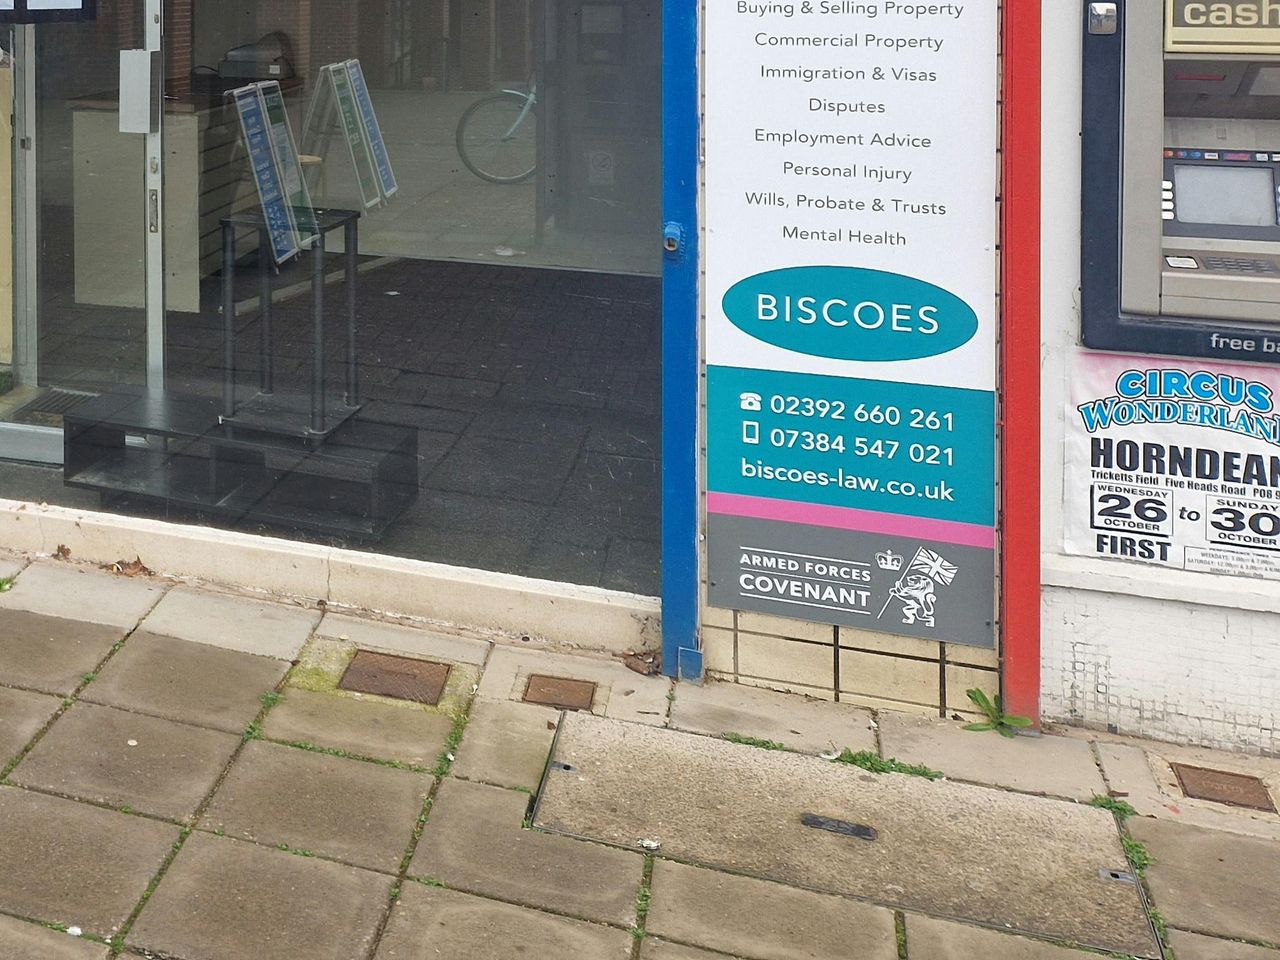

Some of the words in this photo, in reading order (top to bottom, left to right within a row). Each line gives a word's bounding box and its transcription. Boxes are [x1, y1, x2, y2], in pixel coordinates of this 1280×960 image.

[737, 0, 794, 18] Buying
[800, 0, 814, 14] &
[820, 0, 878, 19] Selling
[885, 1, 964, 20] Property
[754, 32, 858, 47] Commercial
[865, 33, 944, 53] Property
[761, 64, 865, 83] Immigration
[871, 66, 885, 81] &
[891, 67, 937, 82] Visas
[809, 97, 886, 116] Disputes
[755, 128, 864, 148] Employment
[870, 132, 932, 148] Advice
[783, 161, 857, 178] Personal
[864, 165, 912, 184] Injury
[745, 191, 789, 209] Wills,
[796, 194, 866, 211] Probate
[871, 198, 885, 212] &
[890, 198, 947, 216] Trusts
[783, 225, 842, 242] Mental
[848, 229, 906, 246] Health
[756, 293, 939, 335] BISCOES
[1210, 333, 1256, 351] free
[1117, 370, 1273, 413] CIRCUS
[770, 394, 845, 420] 02392
[854, 403, 901, 426] 660
[909, 408, 953, 432] 261
[770, 428, 846, 454] 07384
[854, 437, 900, 459] 547
[909, 443, 953, 466] 021
[740, 457, 954, 502] biscoes-law.co.uk
[1091, 470, 1133, 483] Tricketts
[1135, 474, 1159, 486] Field
[1165, 477, 1185, 489] Five
[1187, 480, 1219, 493] Heads
[1221, 483, 1246, 496] Road
[1097, 484, 1168, 499] WEDNESDAY
[1097, 493, 1168, 523] 26
[1178, 506, 1201, 522] to
[1216, 498, 1279, 512] SUNDAY
[1104, 518, 1160, 532] OCTOBER
[1210, 507, 1280, 537] 30
[1096, 533, 1172, 562] FIRST
[1217, 532, 1278, 546] OCTOBER
[739, 553, 800, 572] ARMED
[804, 561, 872, 583] FORCES
[739, 573, 871, 607] COVENANT
